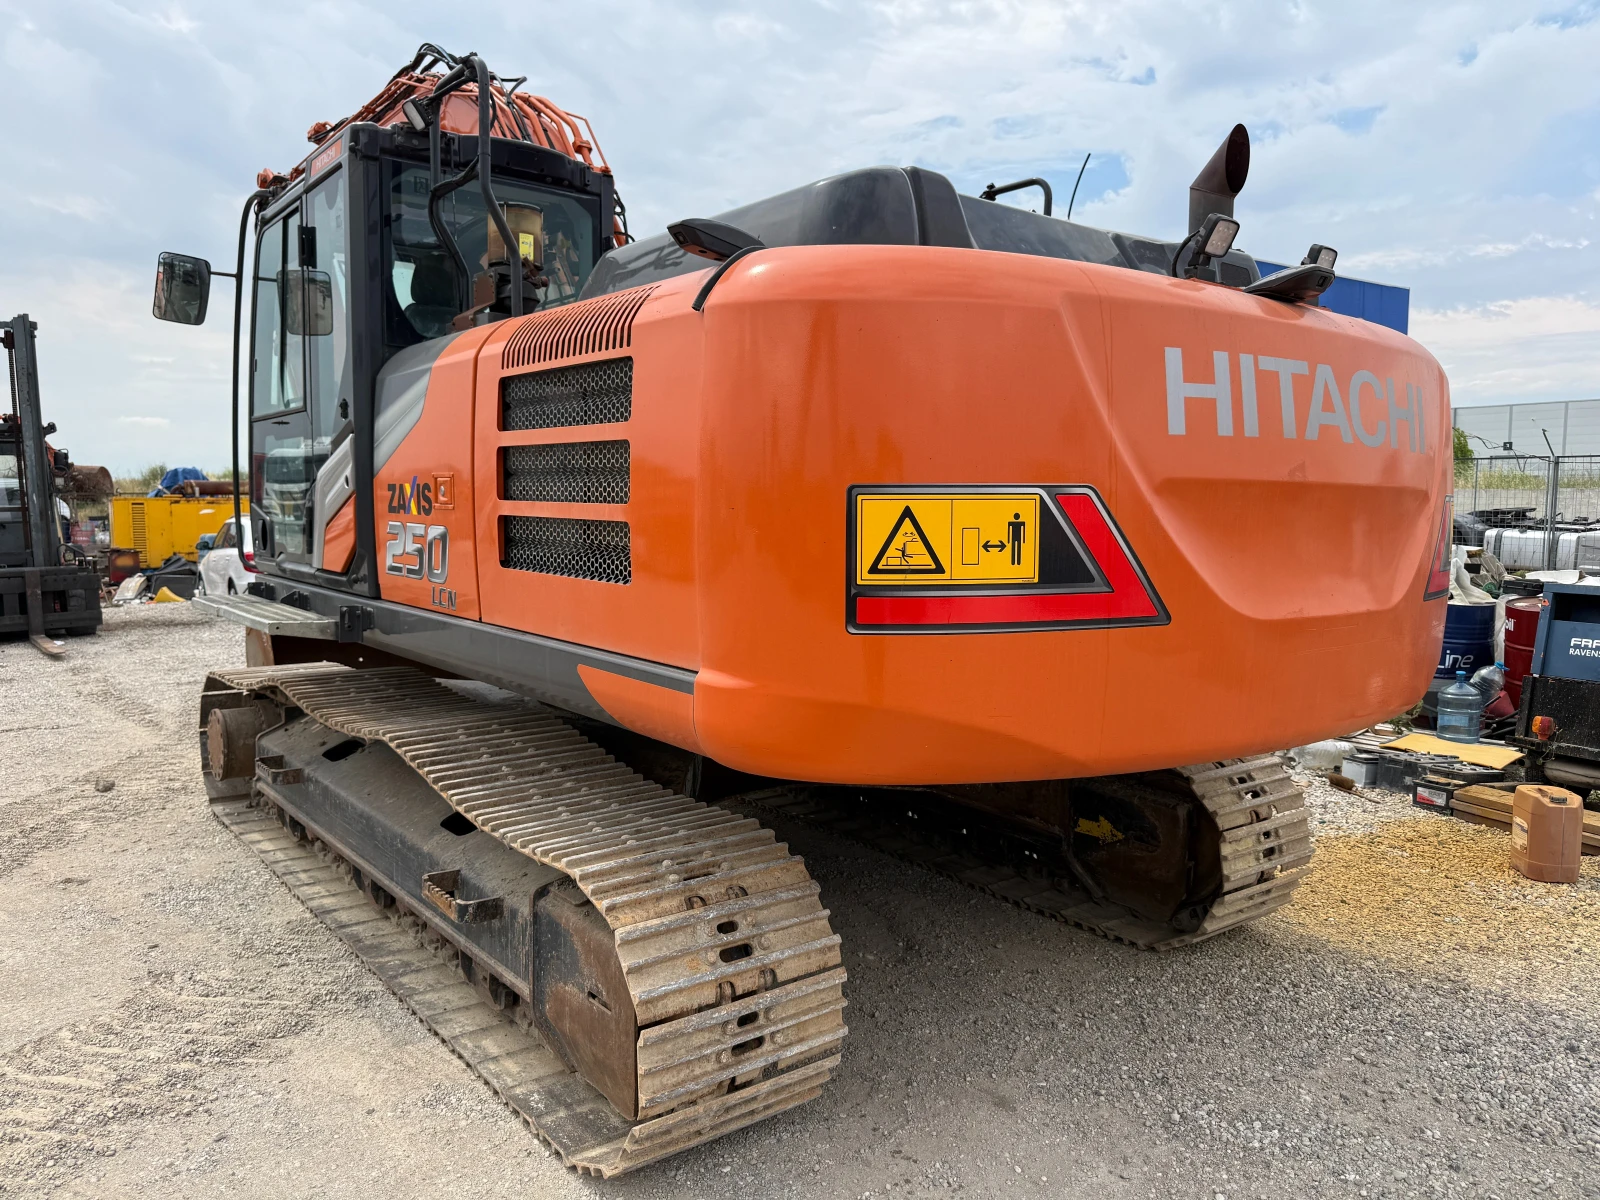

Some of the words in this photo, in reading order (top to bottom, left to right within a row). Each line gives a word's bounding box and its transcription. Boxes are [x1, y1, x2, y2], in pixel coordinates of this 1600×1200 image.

[1164, 346, 1426, 455] HITACHI
[387, 475, 433, 516] ZAXIS
[385, 521, 449, 584] 250
[431, 585, 457, 610] LCN
